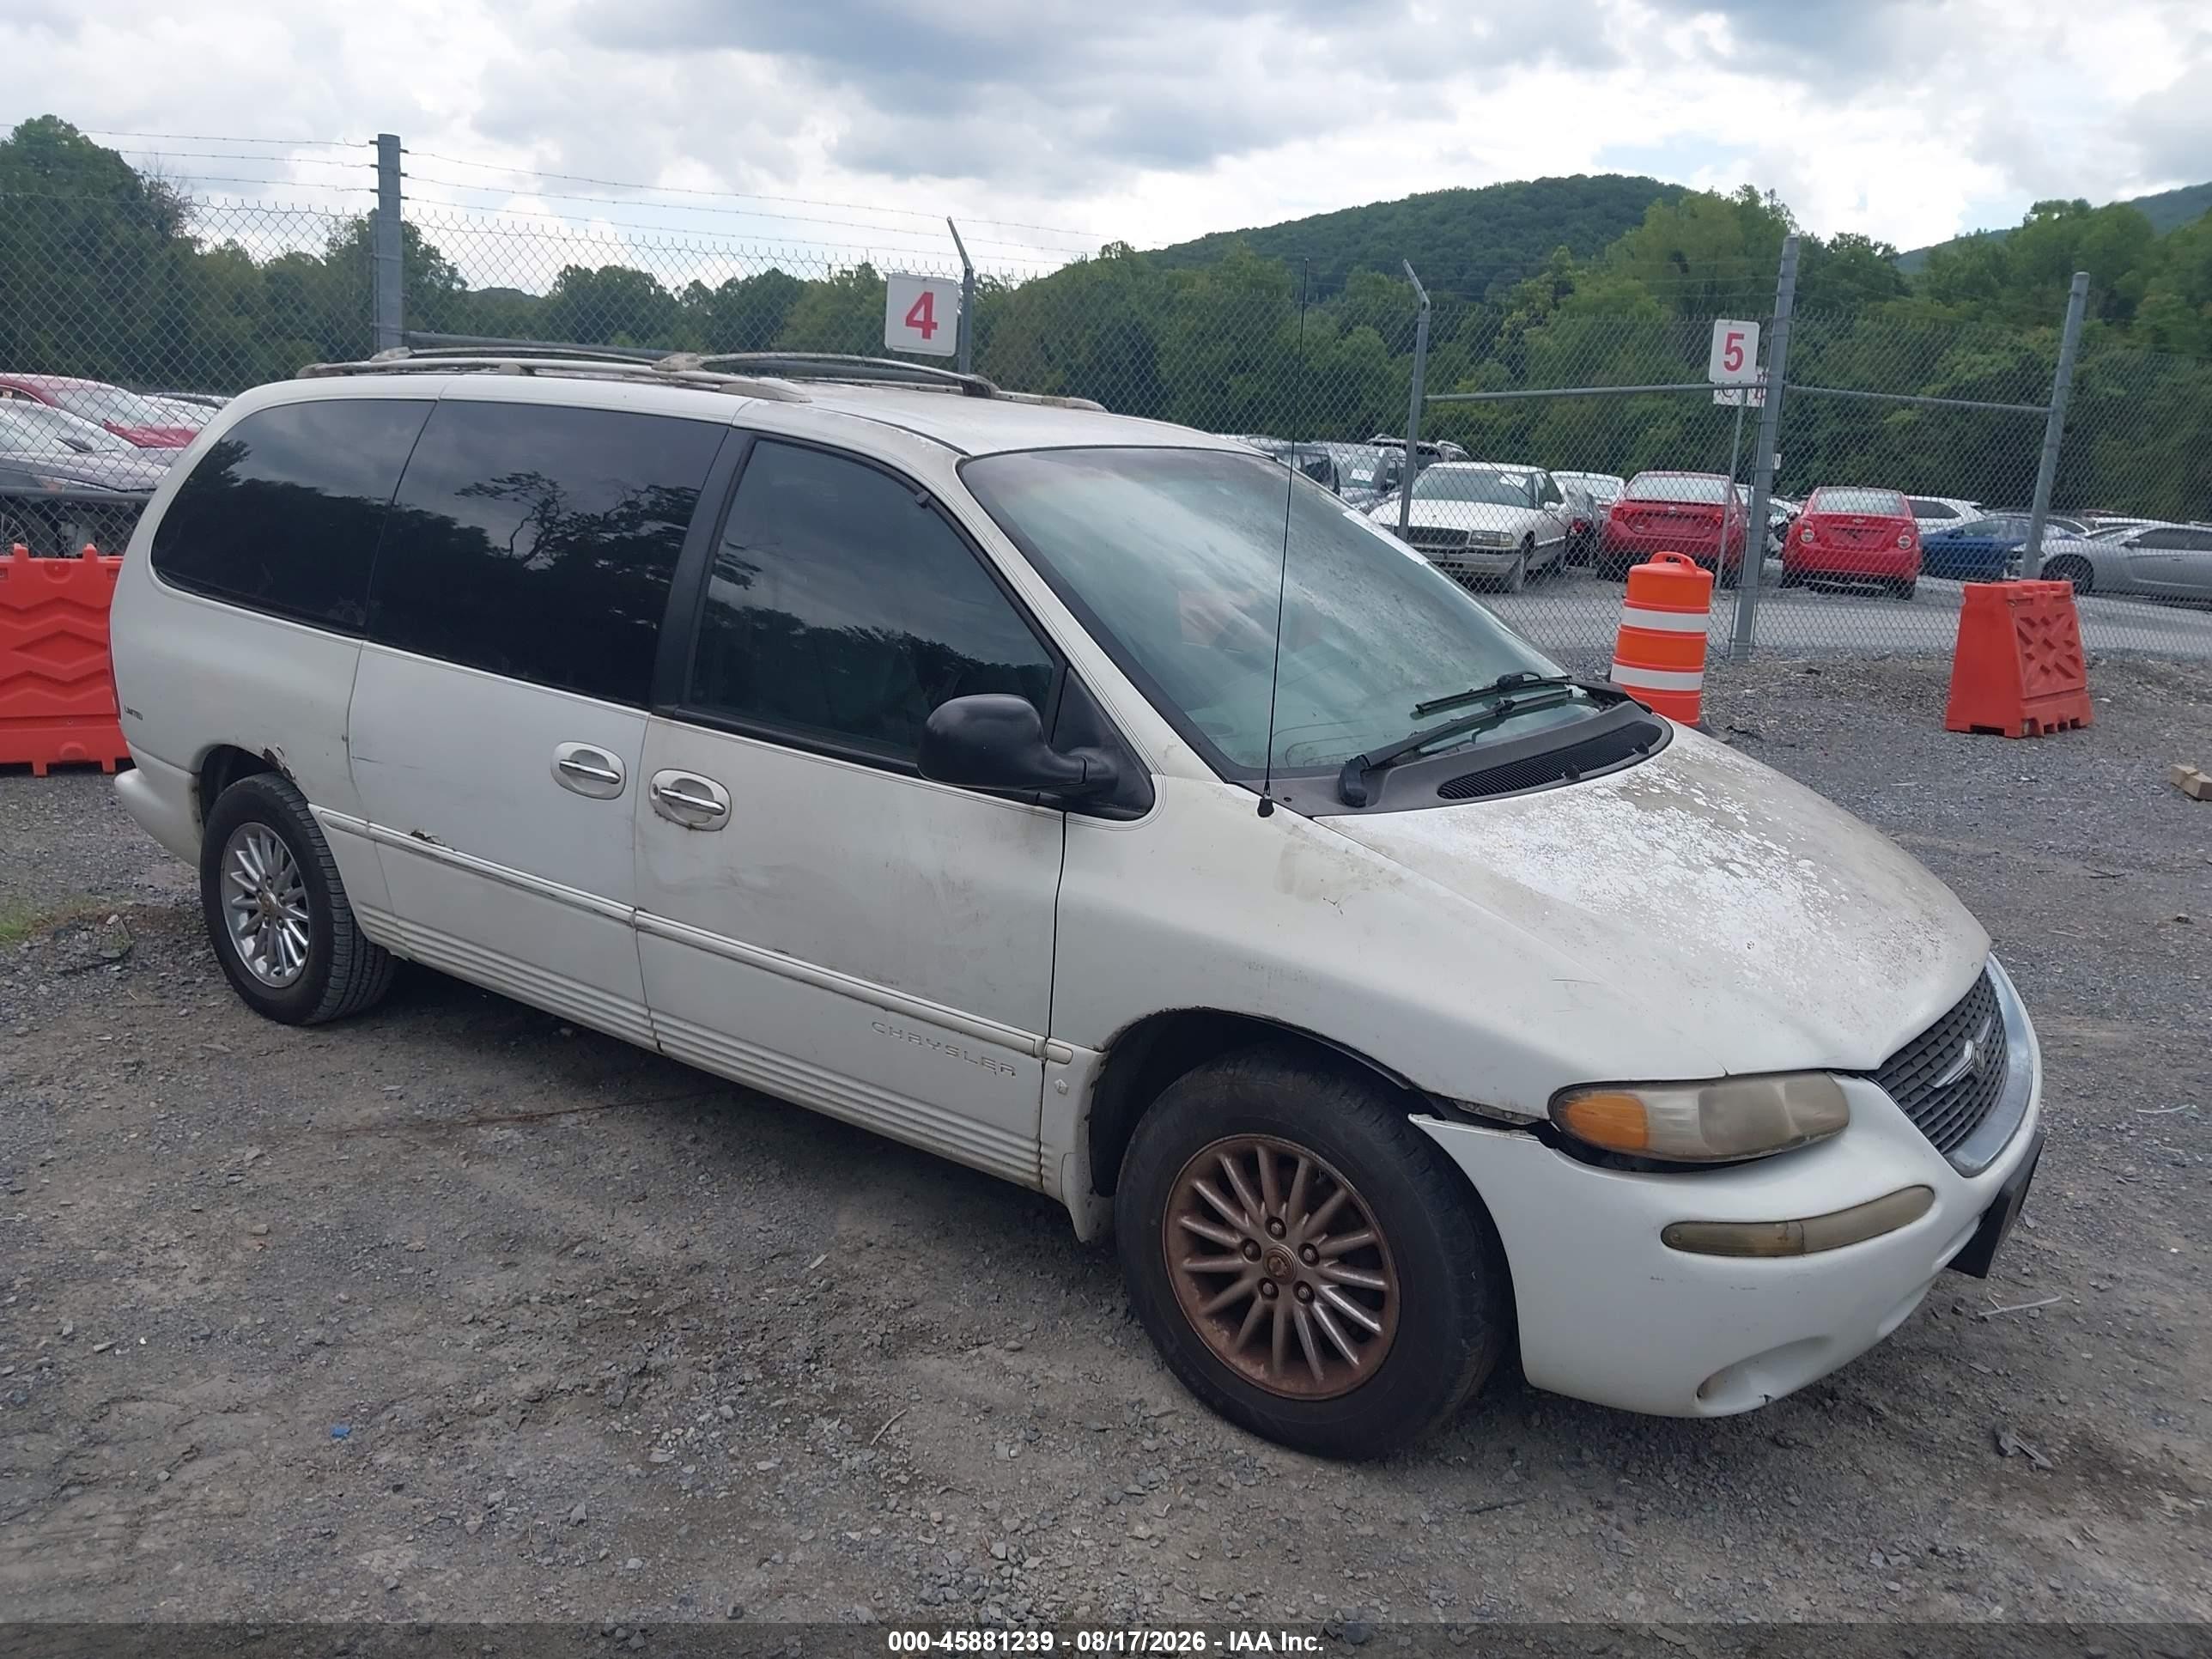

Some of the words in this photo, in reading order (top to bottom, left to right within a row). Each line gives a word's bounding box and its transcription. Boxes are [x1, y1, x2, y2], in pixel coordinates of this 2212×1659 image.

[905, 291, 938, 340] 4
[1723, 332, 1745, 372] 5
[872, 1020, 1017, 1079] CHRYSLER
